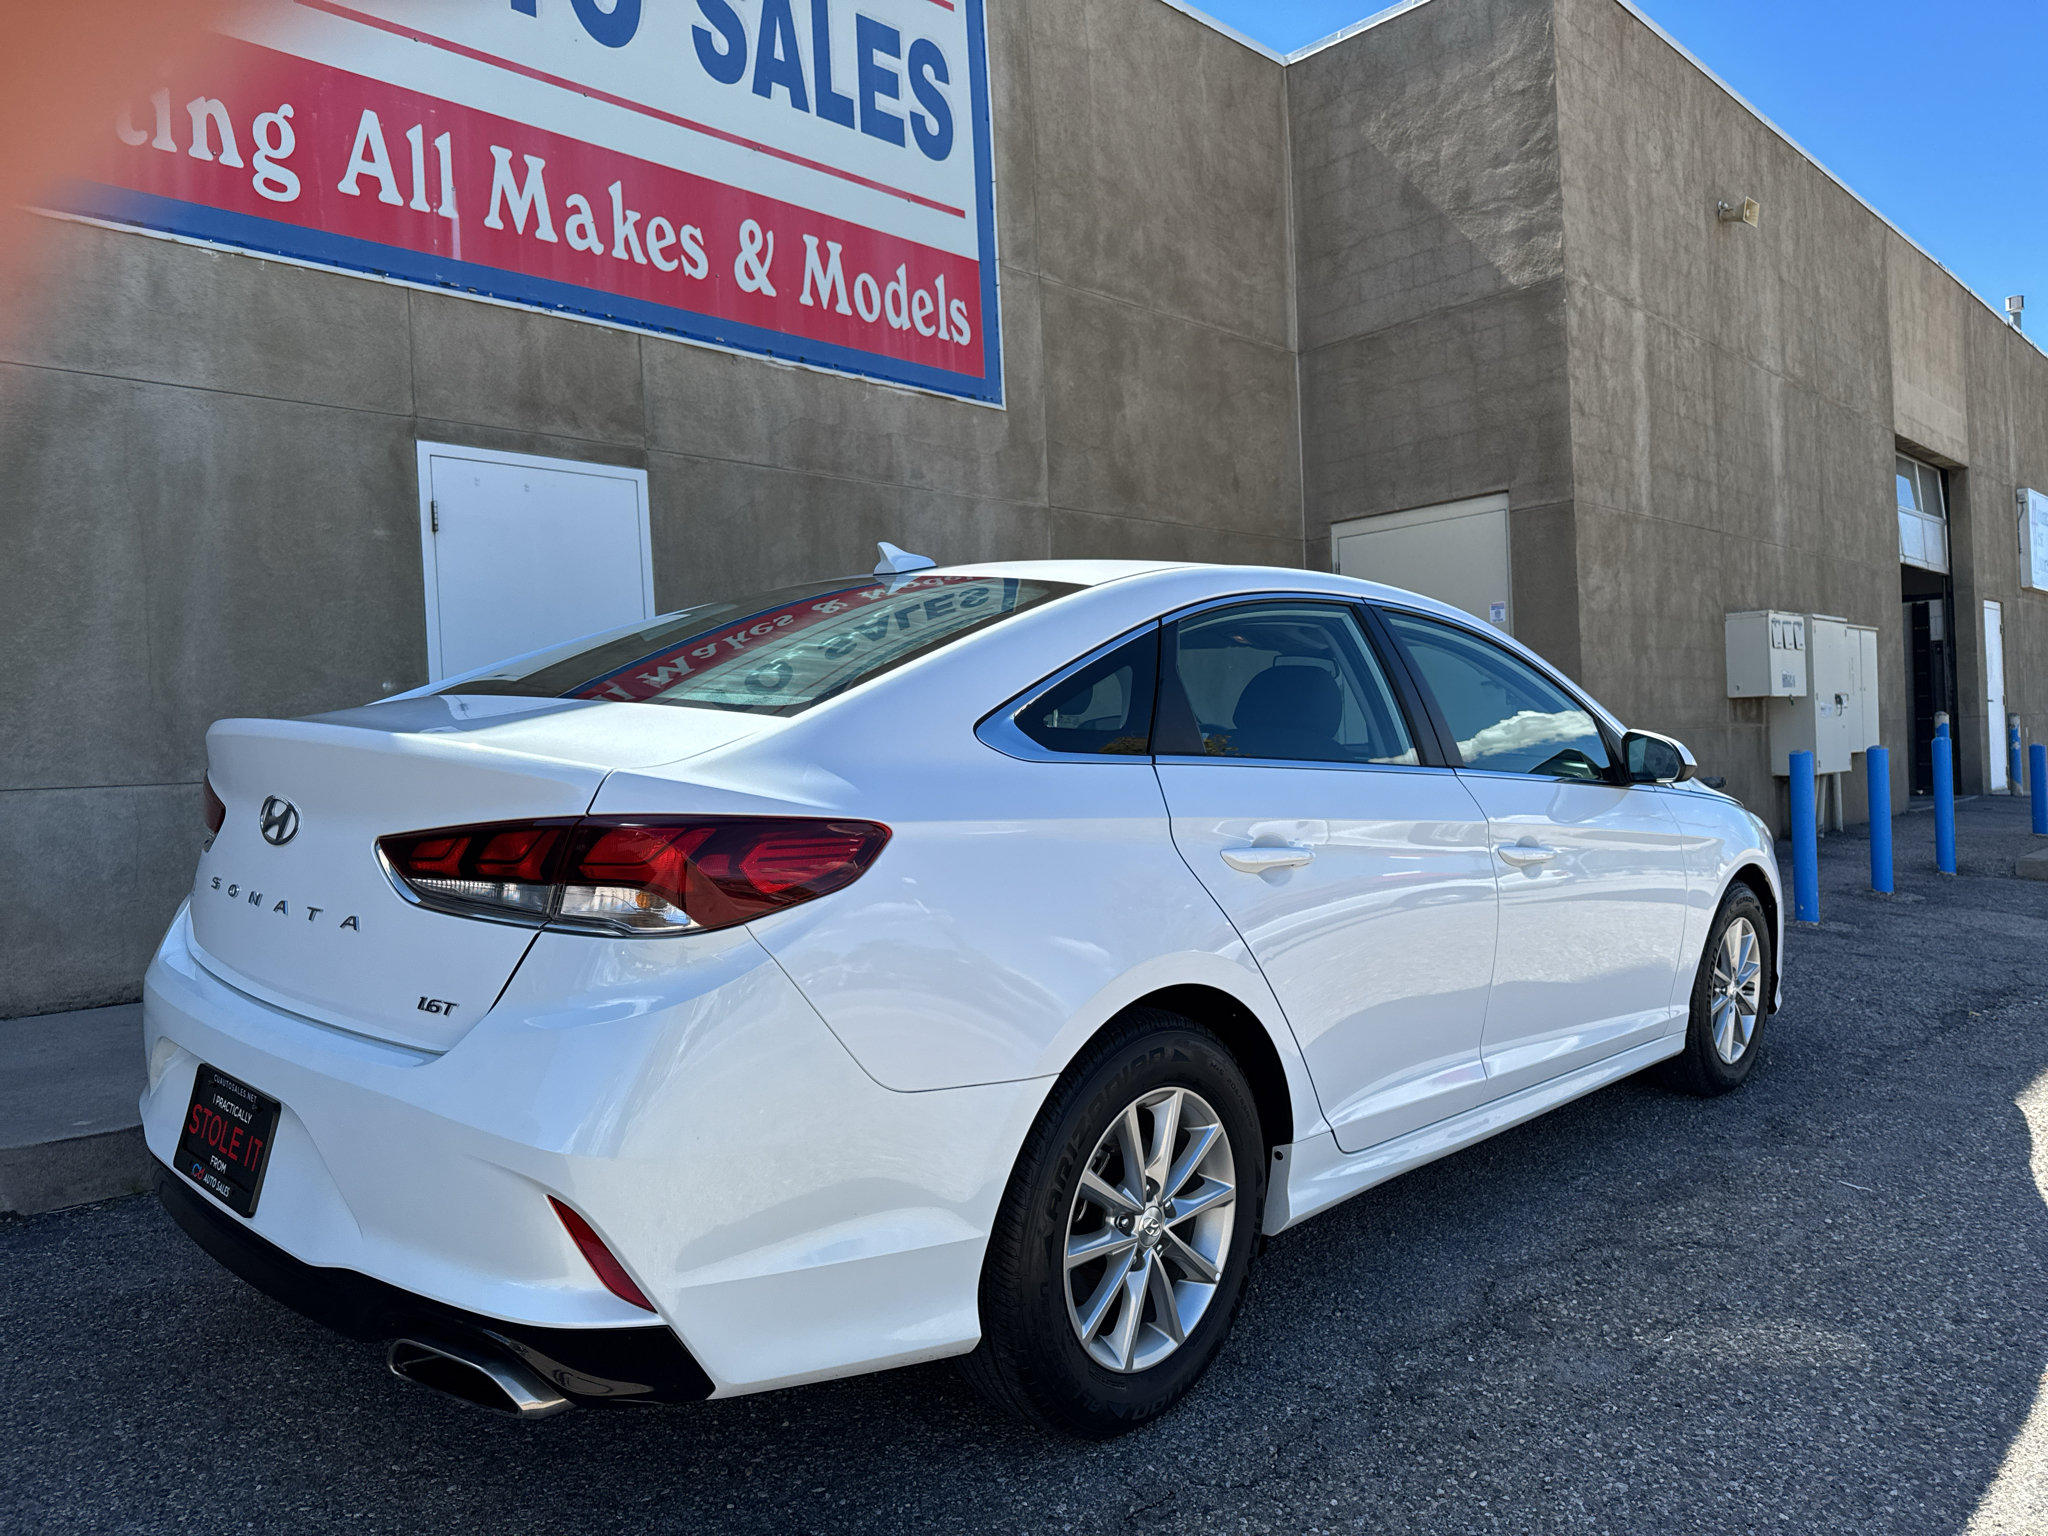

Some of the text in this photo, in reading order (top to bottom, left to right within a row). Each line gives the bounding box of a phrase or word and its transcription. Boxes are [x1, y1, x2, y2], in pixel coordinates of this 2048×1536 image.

[691, 0, 954, 161] SALES
[337, 109, 458, 219] All
[484, 145, 709, 281] Makes
[733, 218, 777, 298] &
[799, 233, 972, 346] Models
[211, 876, 360, 932] SONATA
[188, 1103, 263, 1172] STOLE IT
[215, 1095, 253, 1125] PRACTICALLY
[203, 1173, 217, 1189] AUTO
[216, 1180, 231, 1198] SALES
[209, 1155, 227, 1175] FROM
